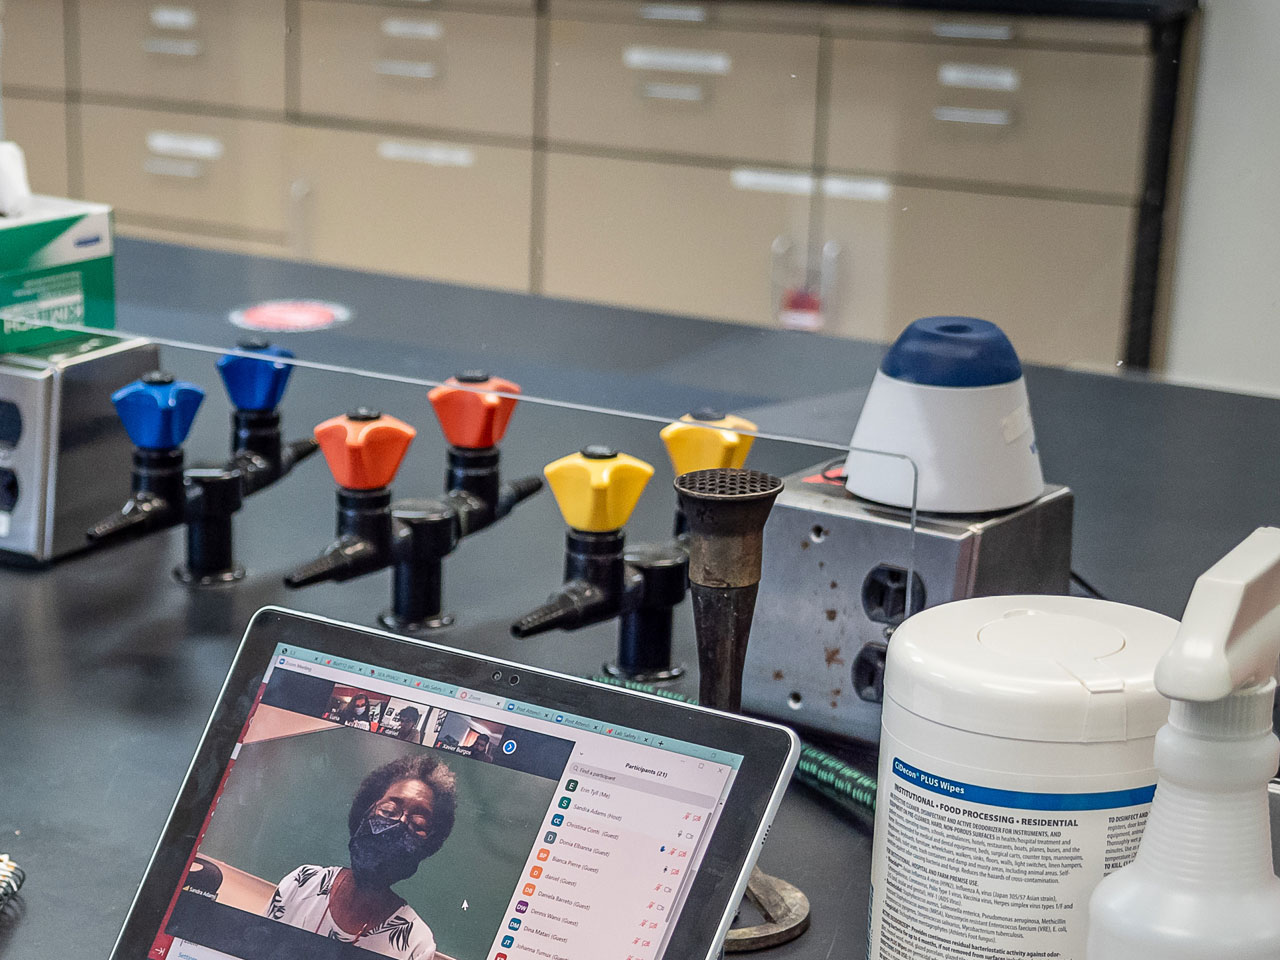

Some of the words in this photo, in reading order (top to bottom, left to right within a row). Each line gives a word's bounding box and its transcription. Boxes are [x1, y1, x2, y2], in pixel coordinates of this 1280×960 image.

[625, 763, 656, 776] Participants
[920, 774, 939, 787] PLUS
[940, 780, 965, 794] Wipes
[940, 803, 961, 815] FOOD
[962, 809, 1014, 824] PROCESSING
[1021, 818, 1078, 827] RESIDENTIAL
